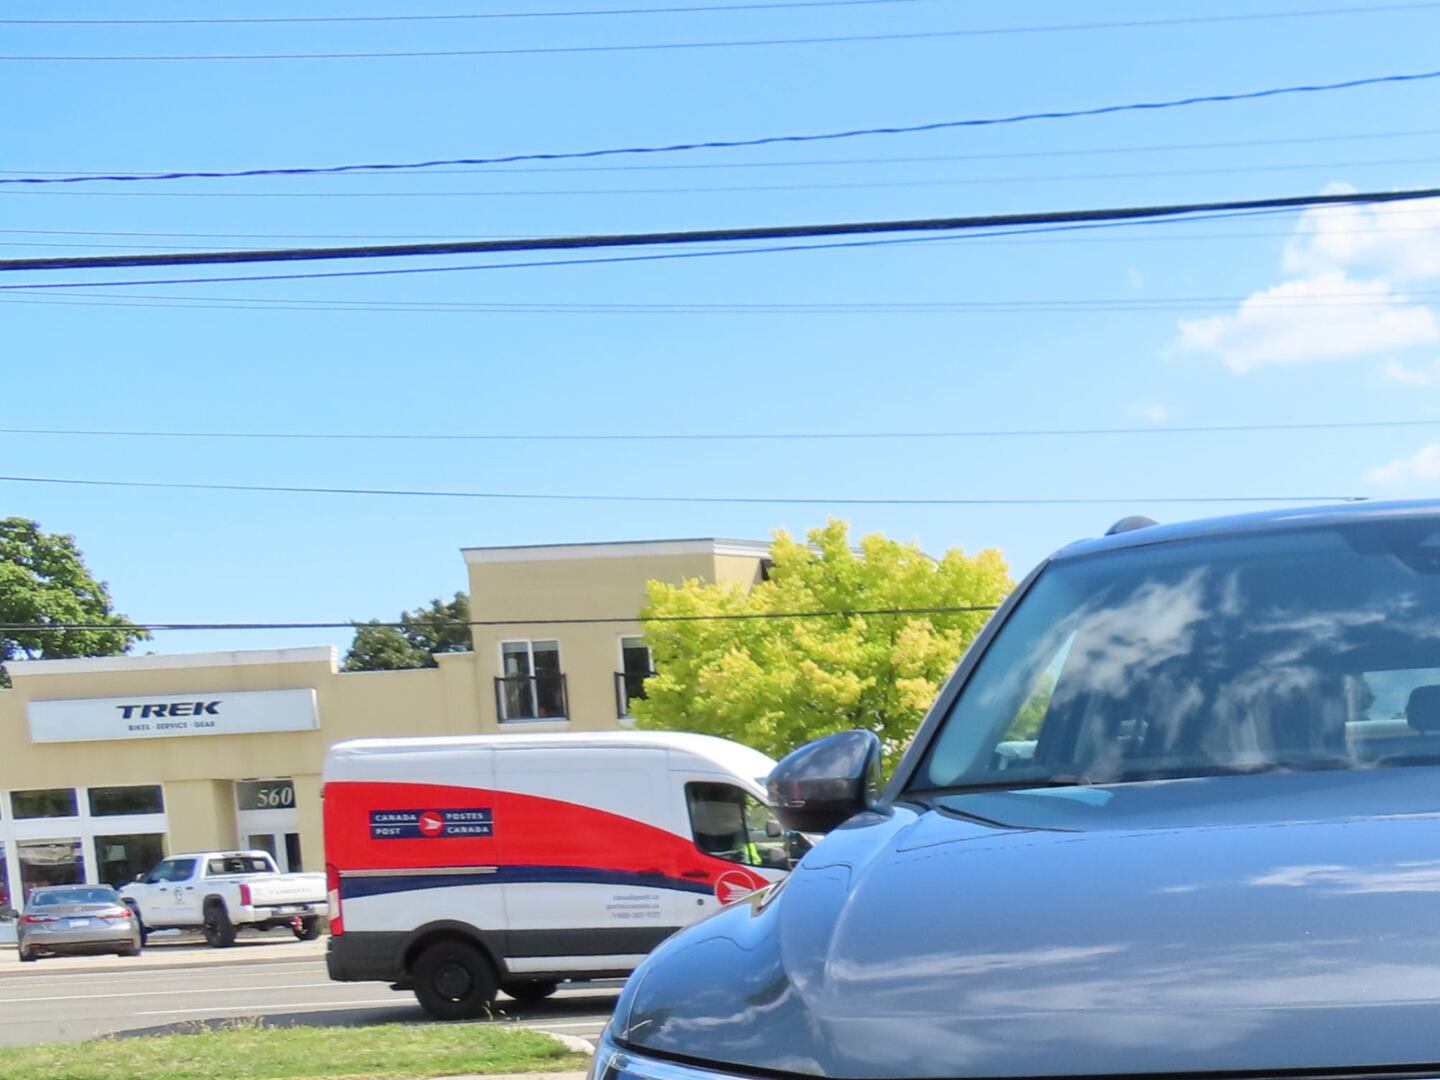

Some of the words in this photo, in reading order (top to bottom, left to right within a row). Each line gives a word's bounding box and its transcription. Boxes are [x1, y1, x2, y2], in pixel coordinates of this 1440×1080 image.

[116, 700, 223, 719] TREK
[156, 722, 188, 730] SERVICE
[257, 787, 292, 807] 560
